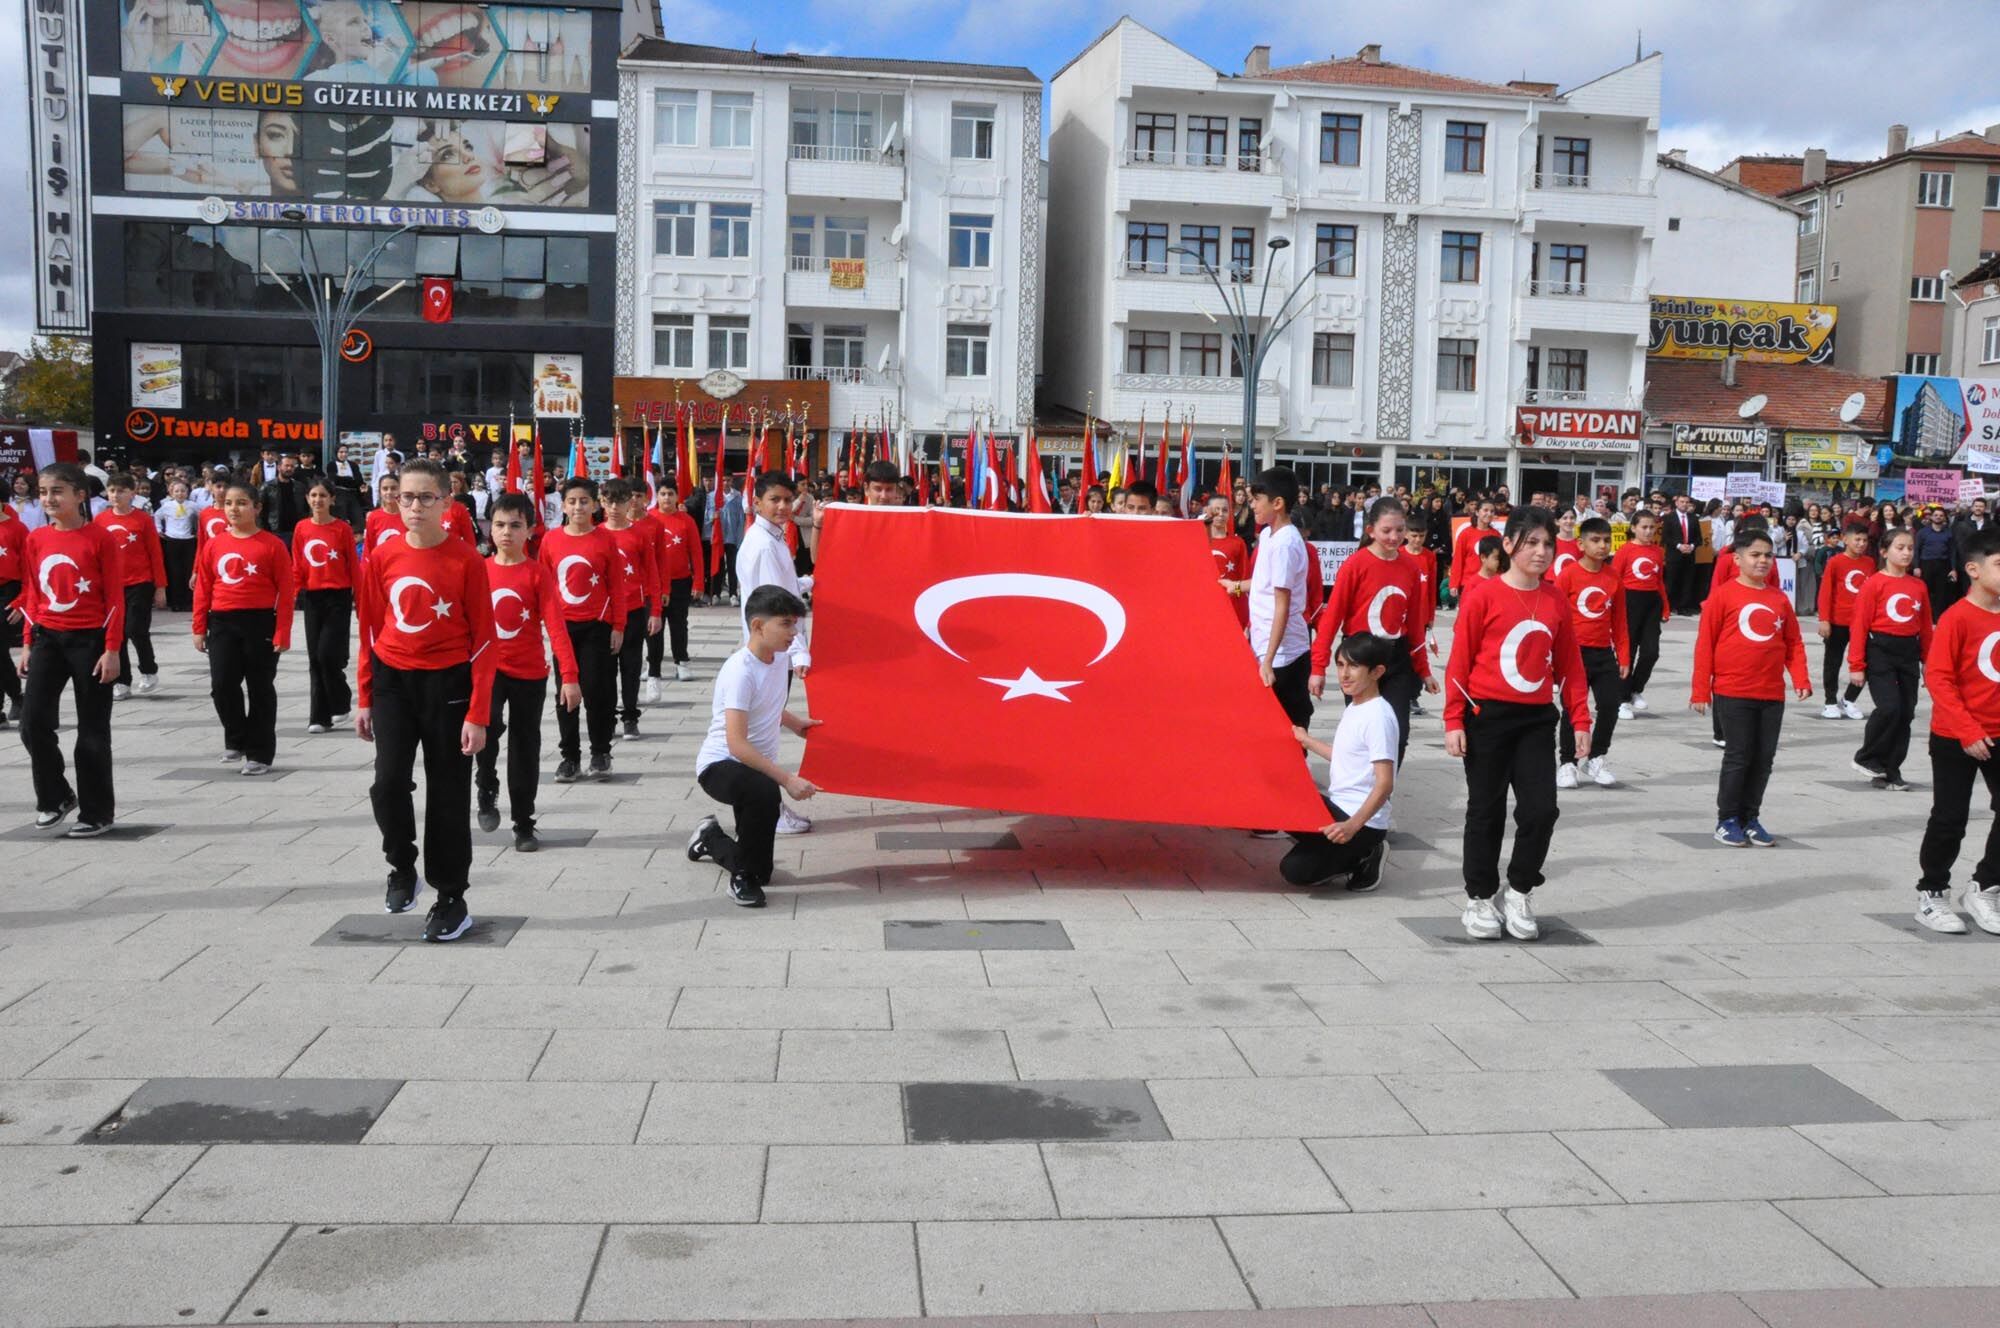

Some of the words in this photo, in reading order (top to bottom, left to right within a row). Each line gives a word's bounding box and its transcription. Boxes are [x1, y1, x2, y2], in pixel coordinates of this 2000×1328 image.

[36, 0, 67, 121] MUTLU
[194, 80, 304, 105] VENÜS
[314, 85, 418, 109] GÜZELLİK
[426, 93, 521, 112] MERKEZİ
[320, 204, 382, 223] EROL
[389, 206, 470, 229] GÜNEŞ
[48, 212, 72, 312] HANI
[1651, 298, 1715, 317] irinler
[1650, 315, 1811, 353] yuncak
[161, 416, 249, 438] Tavada
[1540, 412, 1636, 434] MEYDAN
[1546, 438, 1567, 448] Okey
[1582, 439, 1599, 449] Çay
[1600, 440, 1632, 449] Salonu
[1699, 428, 1753, 444] TUTKUM
[0, 448, 26, 457] URİYET
[1675, 443, 1712, 453] ERKEK
[1714, 444, 1765, 455] KUAFÖRÜ
